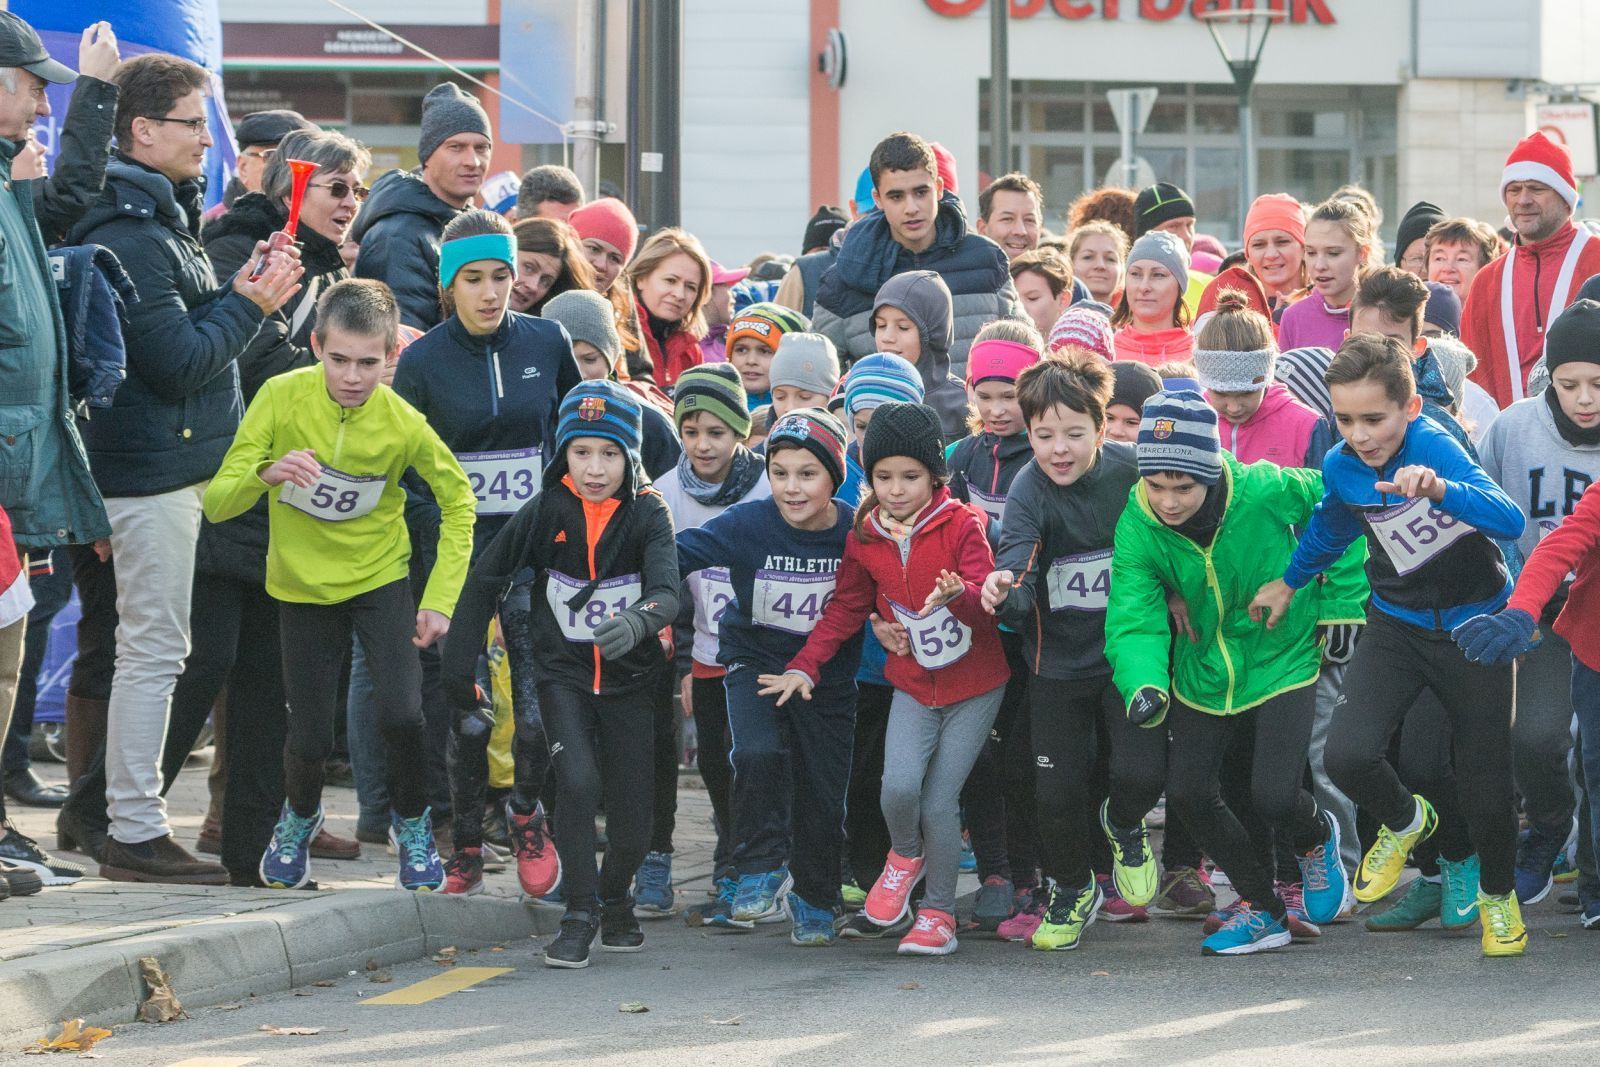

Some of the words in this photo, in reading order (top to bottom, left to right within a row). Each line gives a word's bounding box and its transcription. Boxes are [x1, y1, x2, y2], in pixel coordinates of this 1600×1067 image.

[311, 483, 359, 513] 58
[468, 469, 533, 501] 243
[1390, 507, 1458, 555] 158
[563, 597, 626, 629] 181
[906, 616, 963, 657] 153
